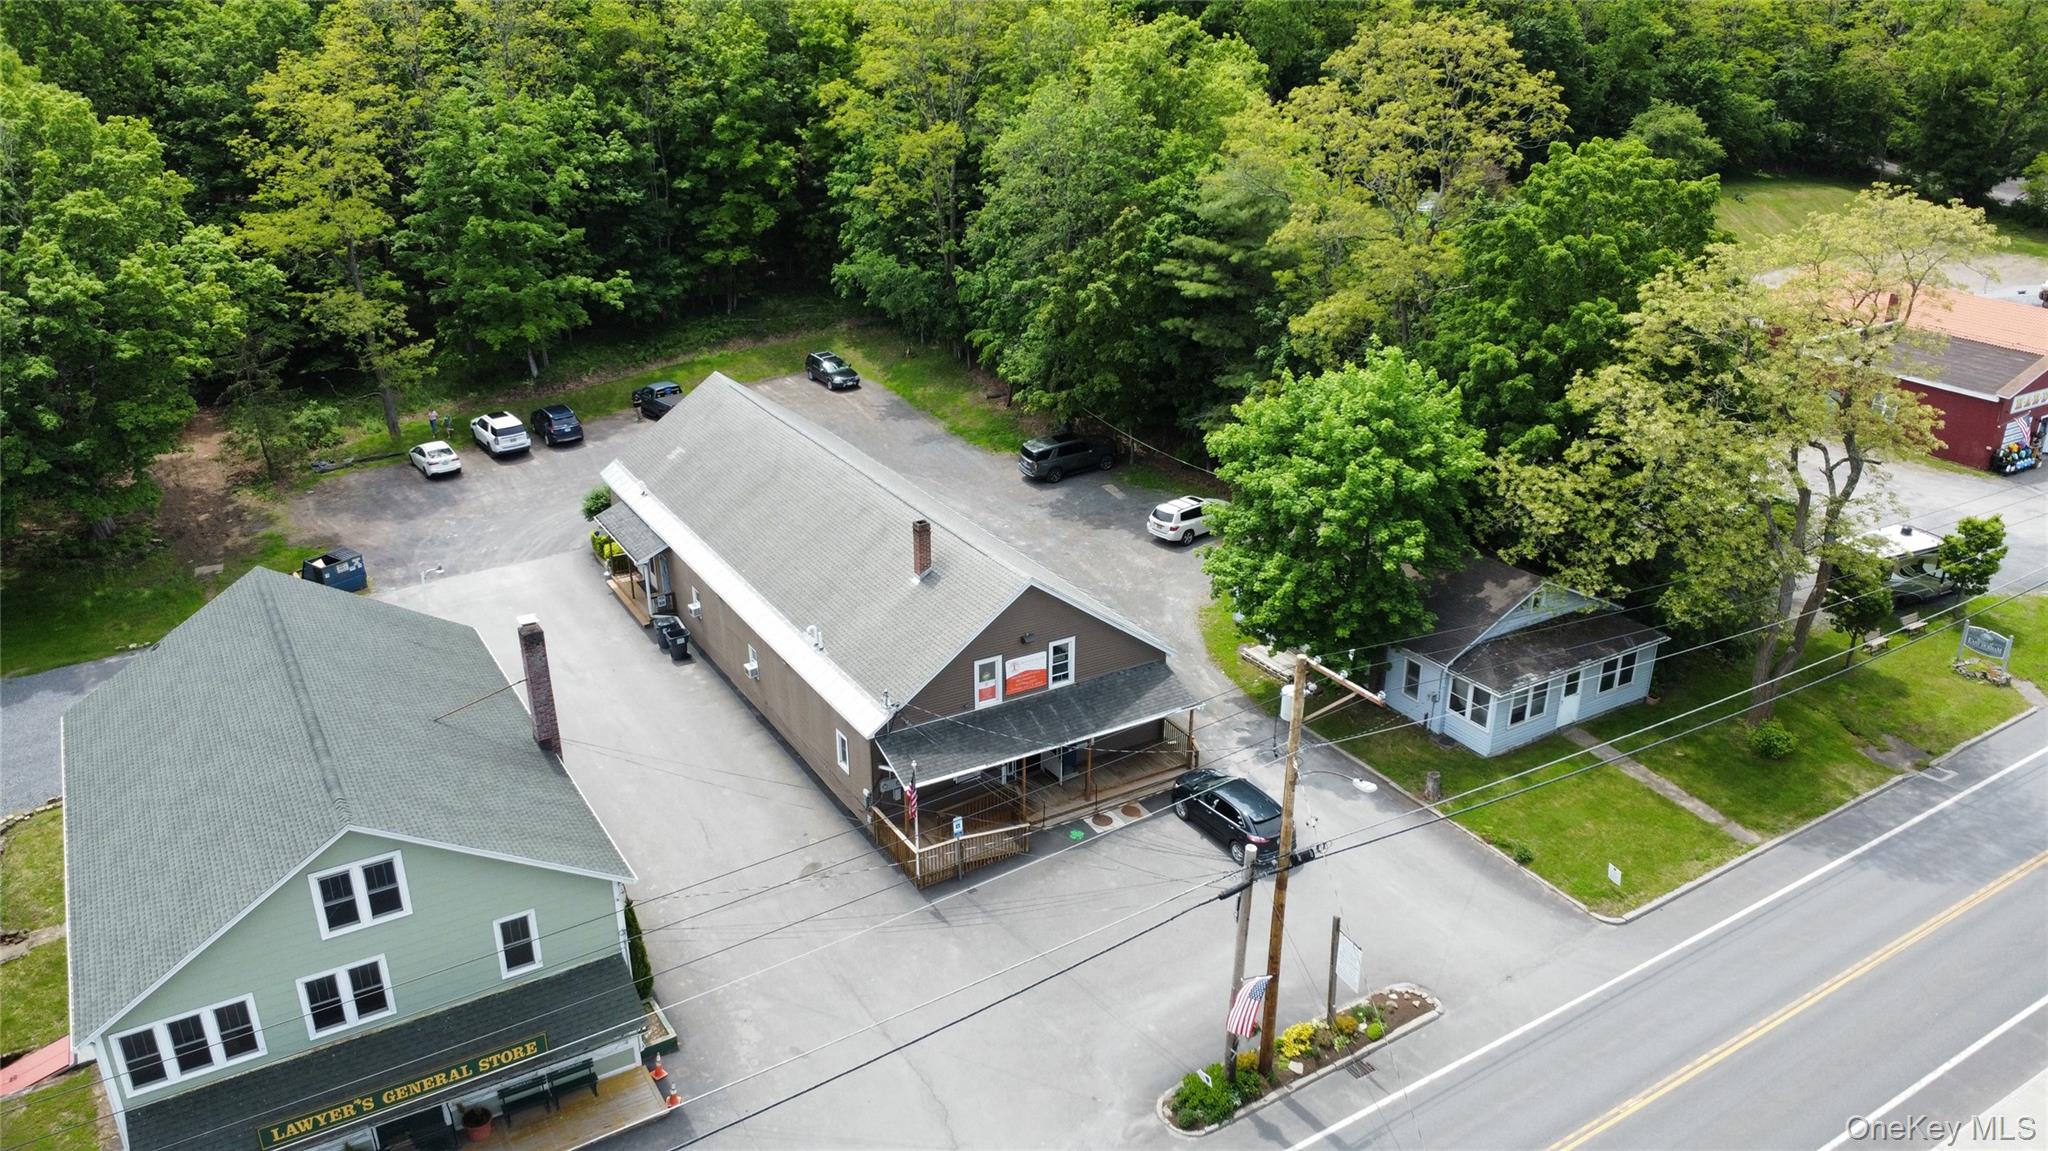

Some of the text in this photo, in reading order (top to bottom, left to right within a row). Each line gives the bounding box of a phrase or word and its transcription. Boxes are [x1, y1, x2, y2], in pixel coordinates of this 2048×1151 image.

[271, 1041, 537, 1141] LAWYER'S GENERAL STORE
